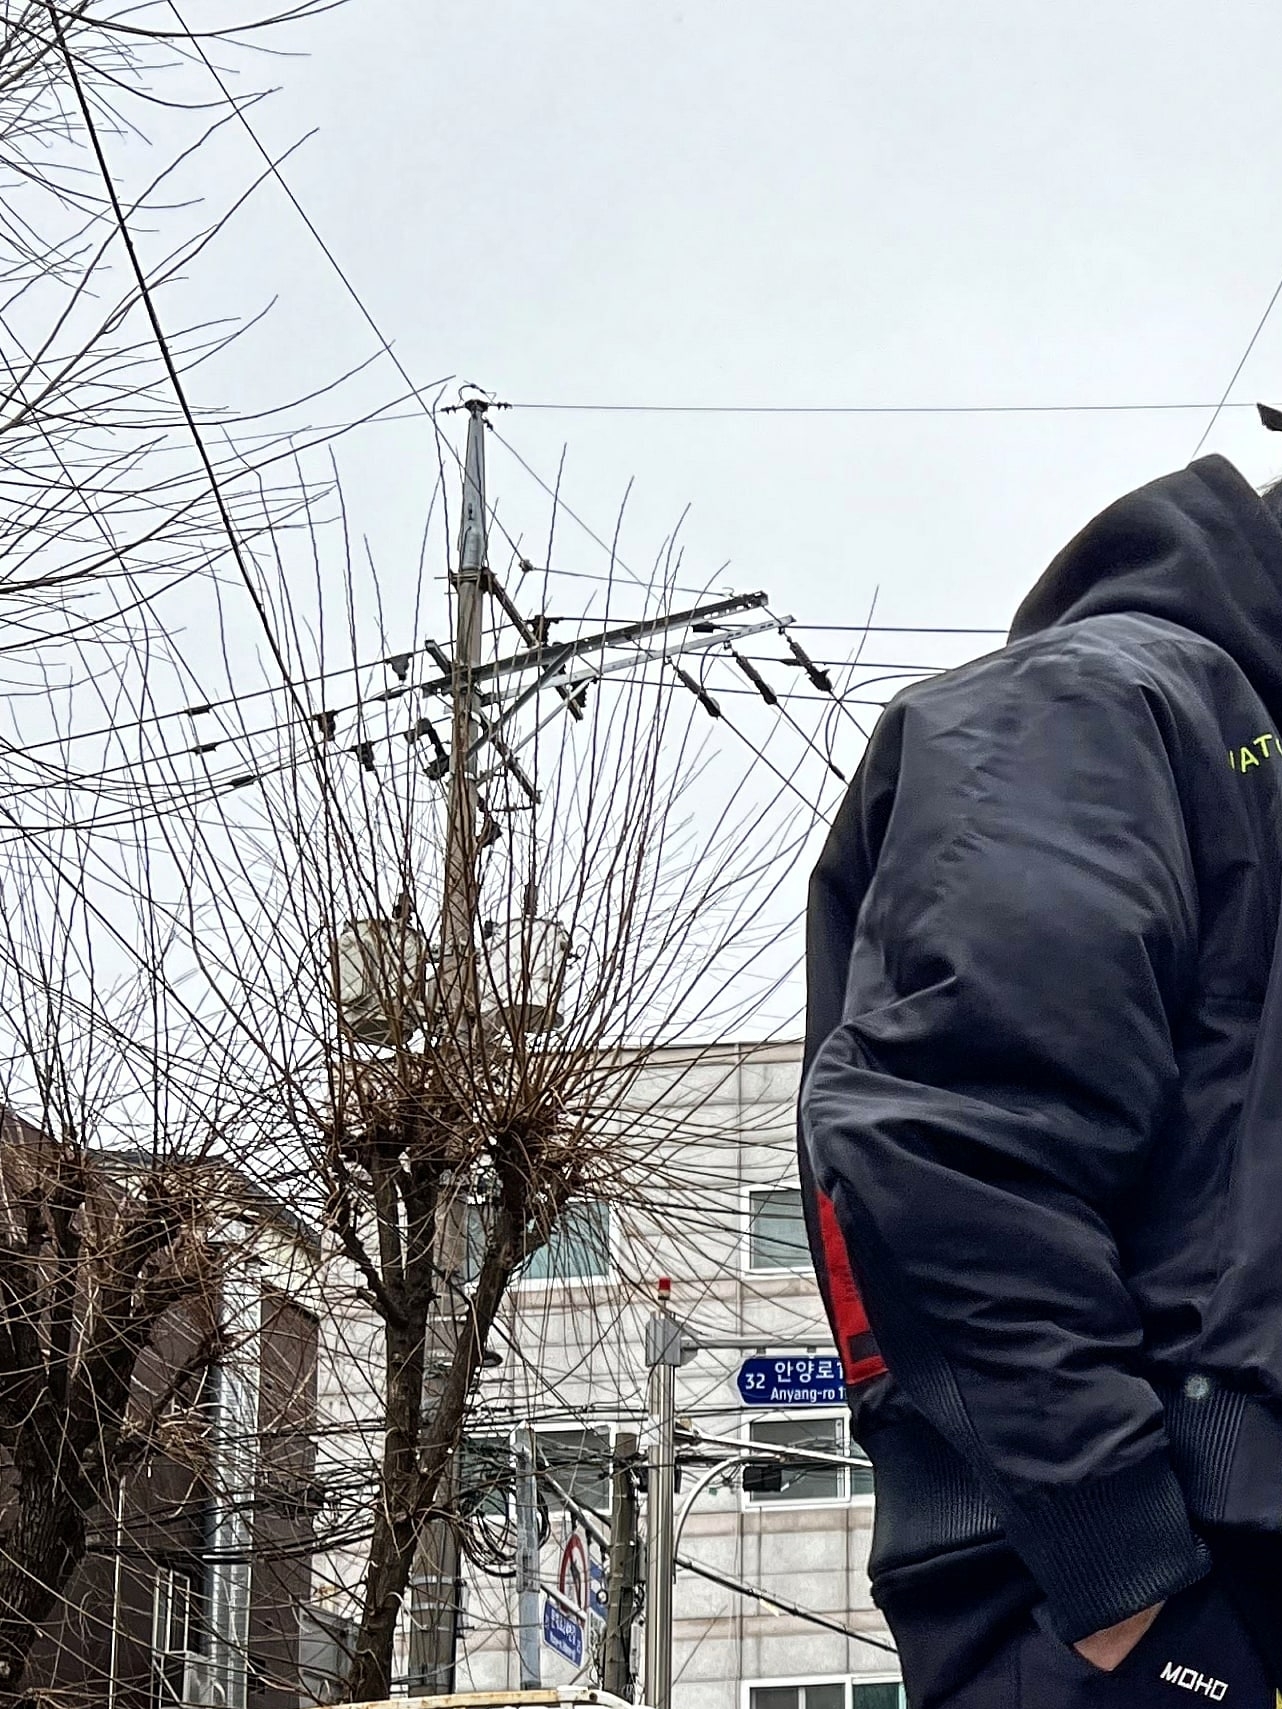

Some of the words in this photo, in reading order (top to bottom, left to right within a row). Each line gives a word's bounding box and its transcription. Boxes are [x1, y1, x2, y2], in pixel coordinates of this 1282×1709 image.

[745, 1373, 766, 1390] 32
[770, 1386, 836, 1403] Anyang-ro
[1160, 1661, 1229, 1701] MOHO
